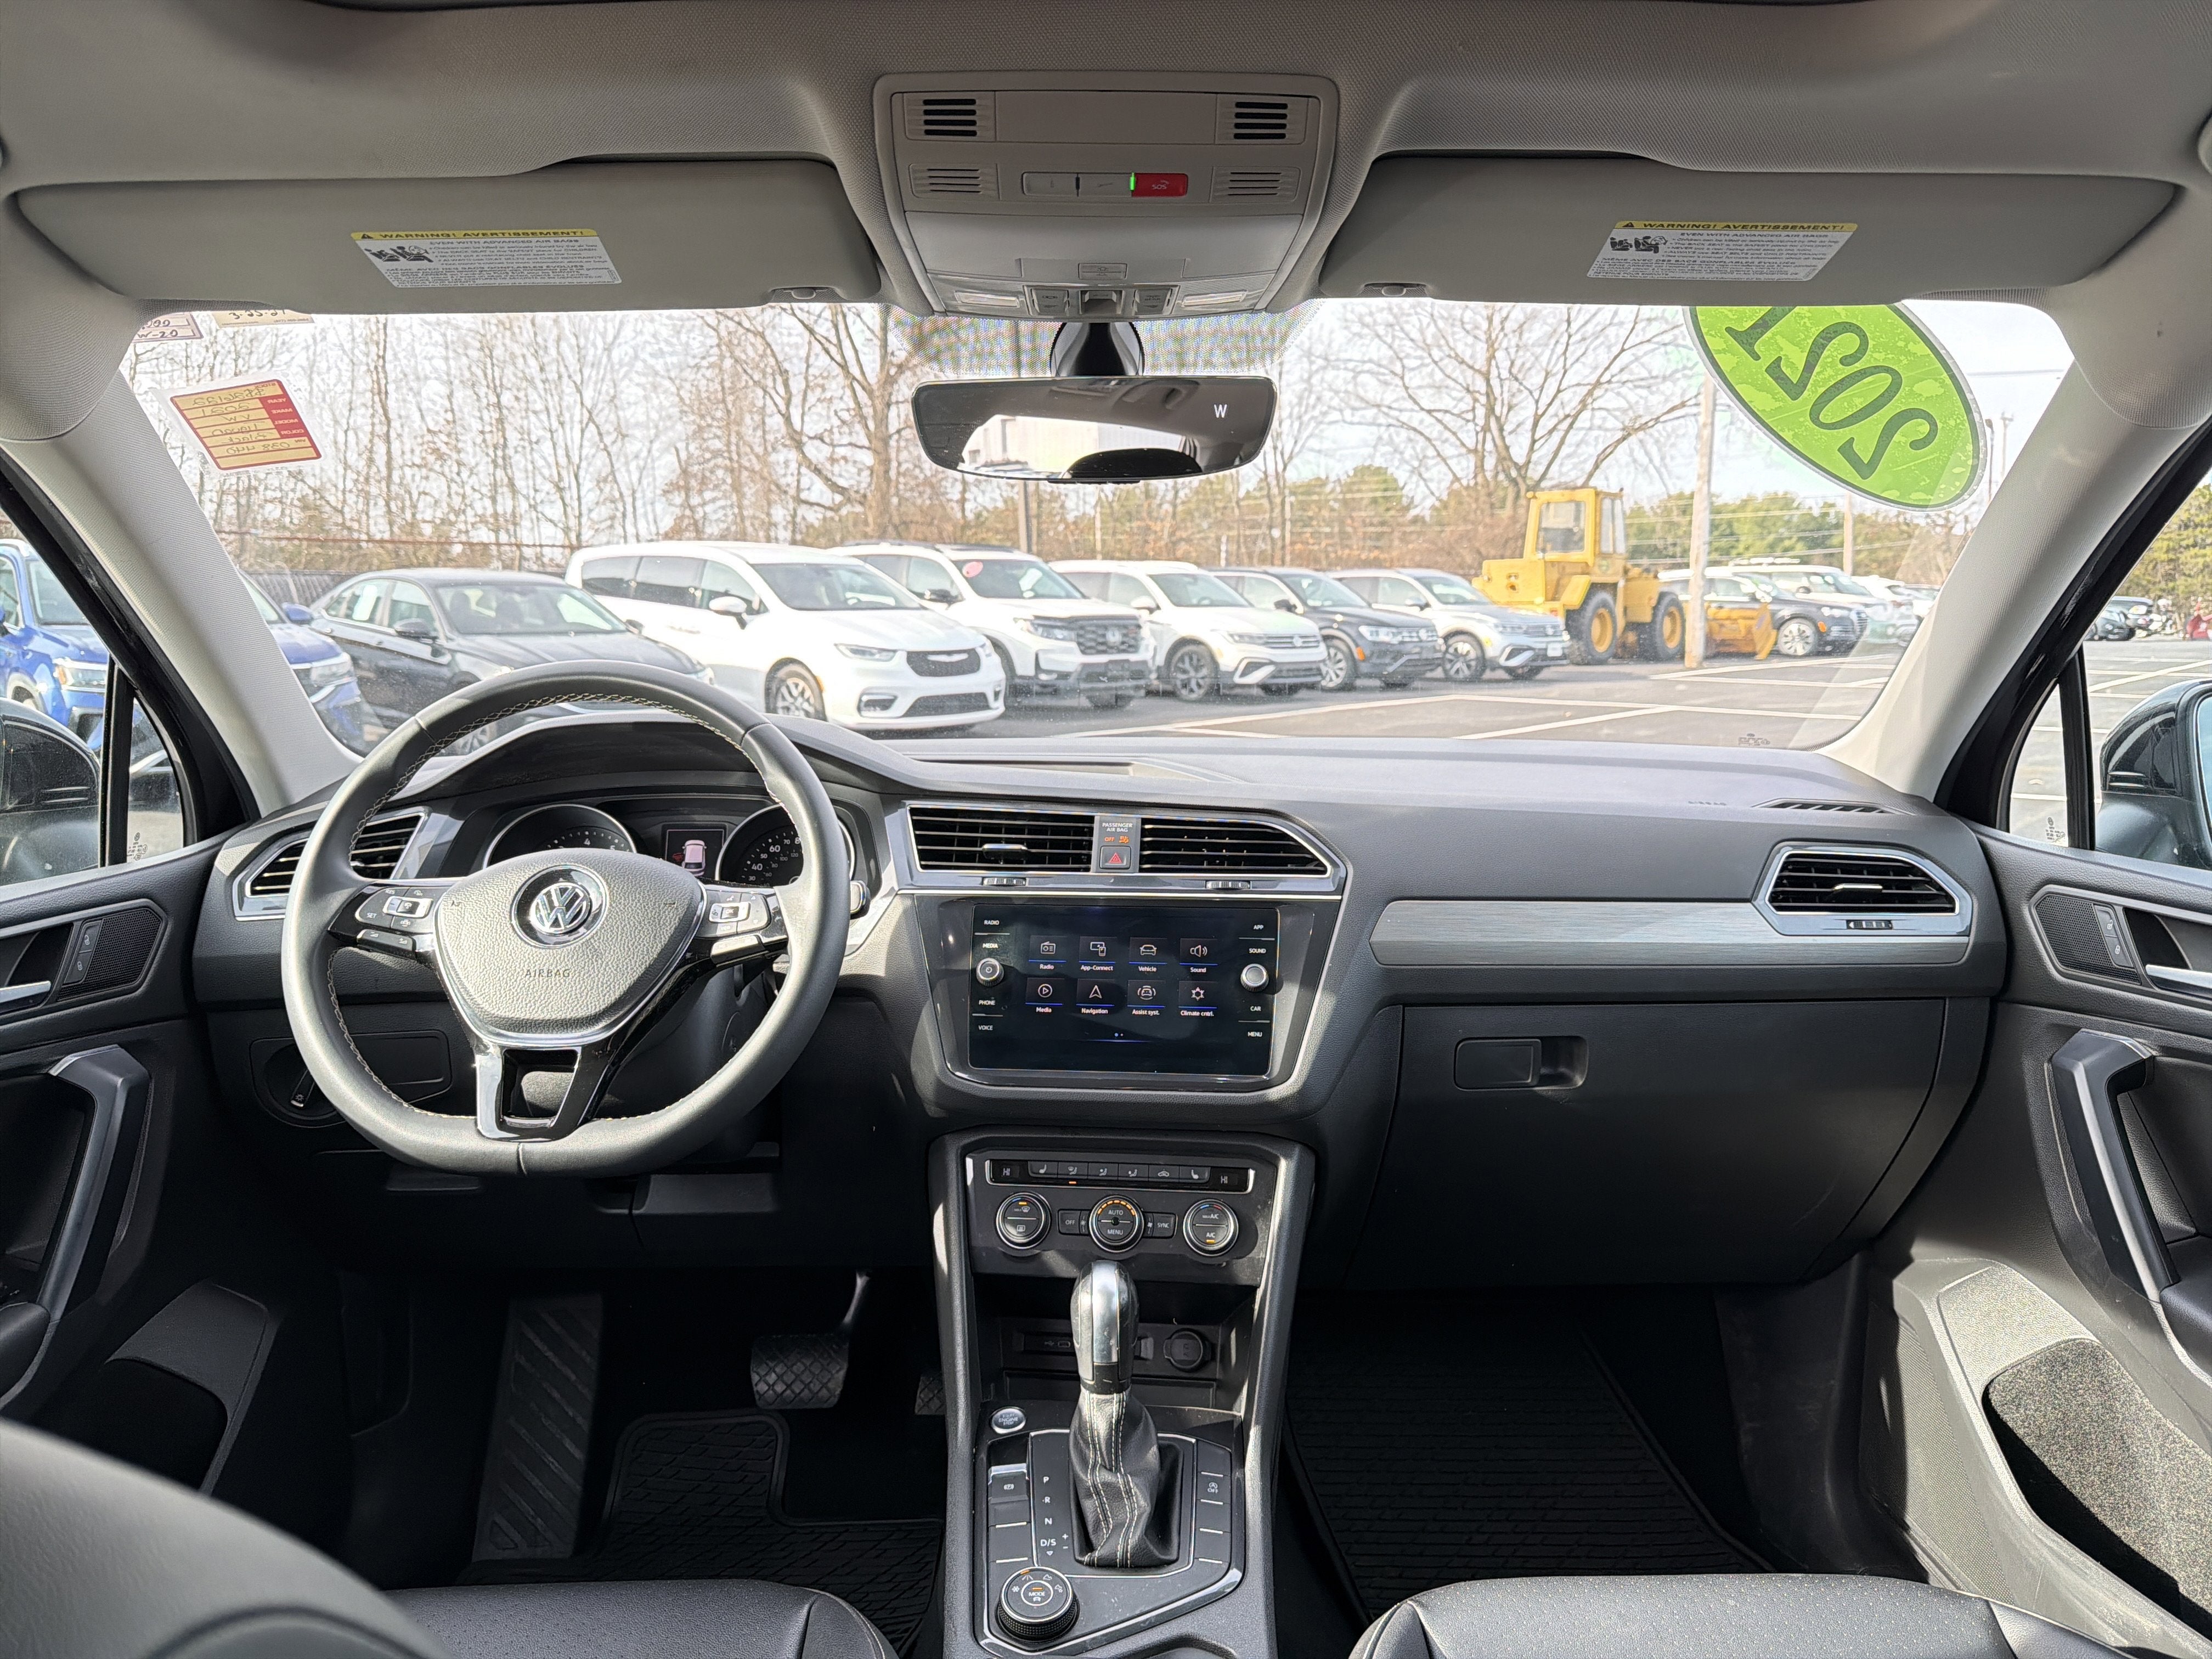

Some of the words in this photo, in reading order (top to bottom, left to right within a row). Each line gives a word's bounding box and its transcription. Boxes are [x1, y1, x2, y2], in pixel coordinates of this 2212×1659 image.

[1214, 404, 1227, 418] W
[525, 969, 570, 978] AIRBAG
[1002, 1167, 1010, 1176] HI
[1221, 1176, 1228, 1184] HI
[1040, 1538, 1056, 1547] D/S
